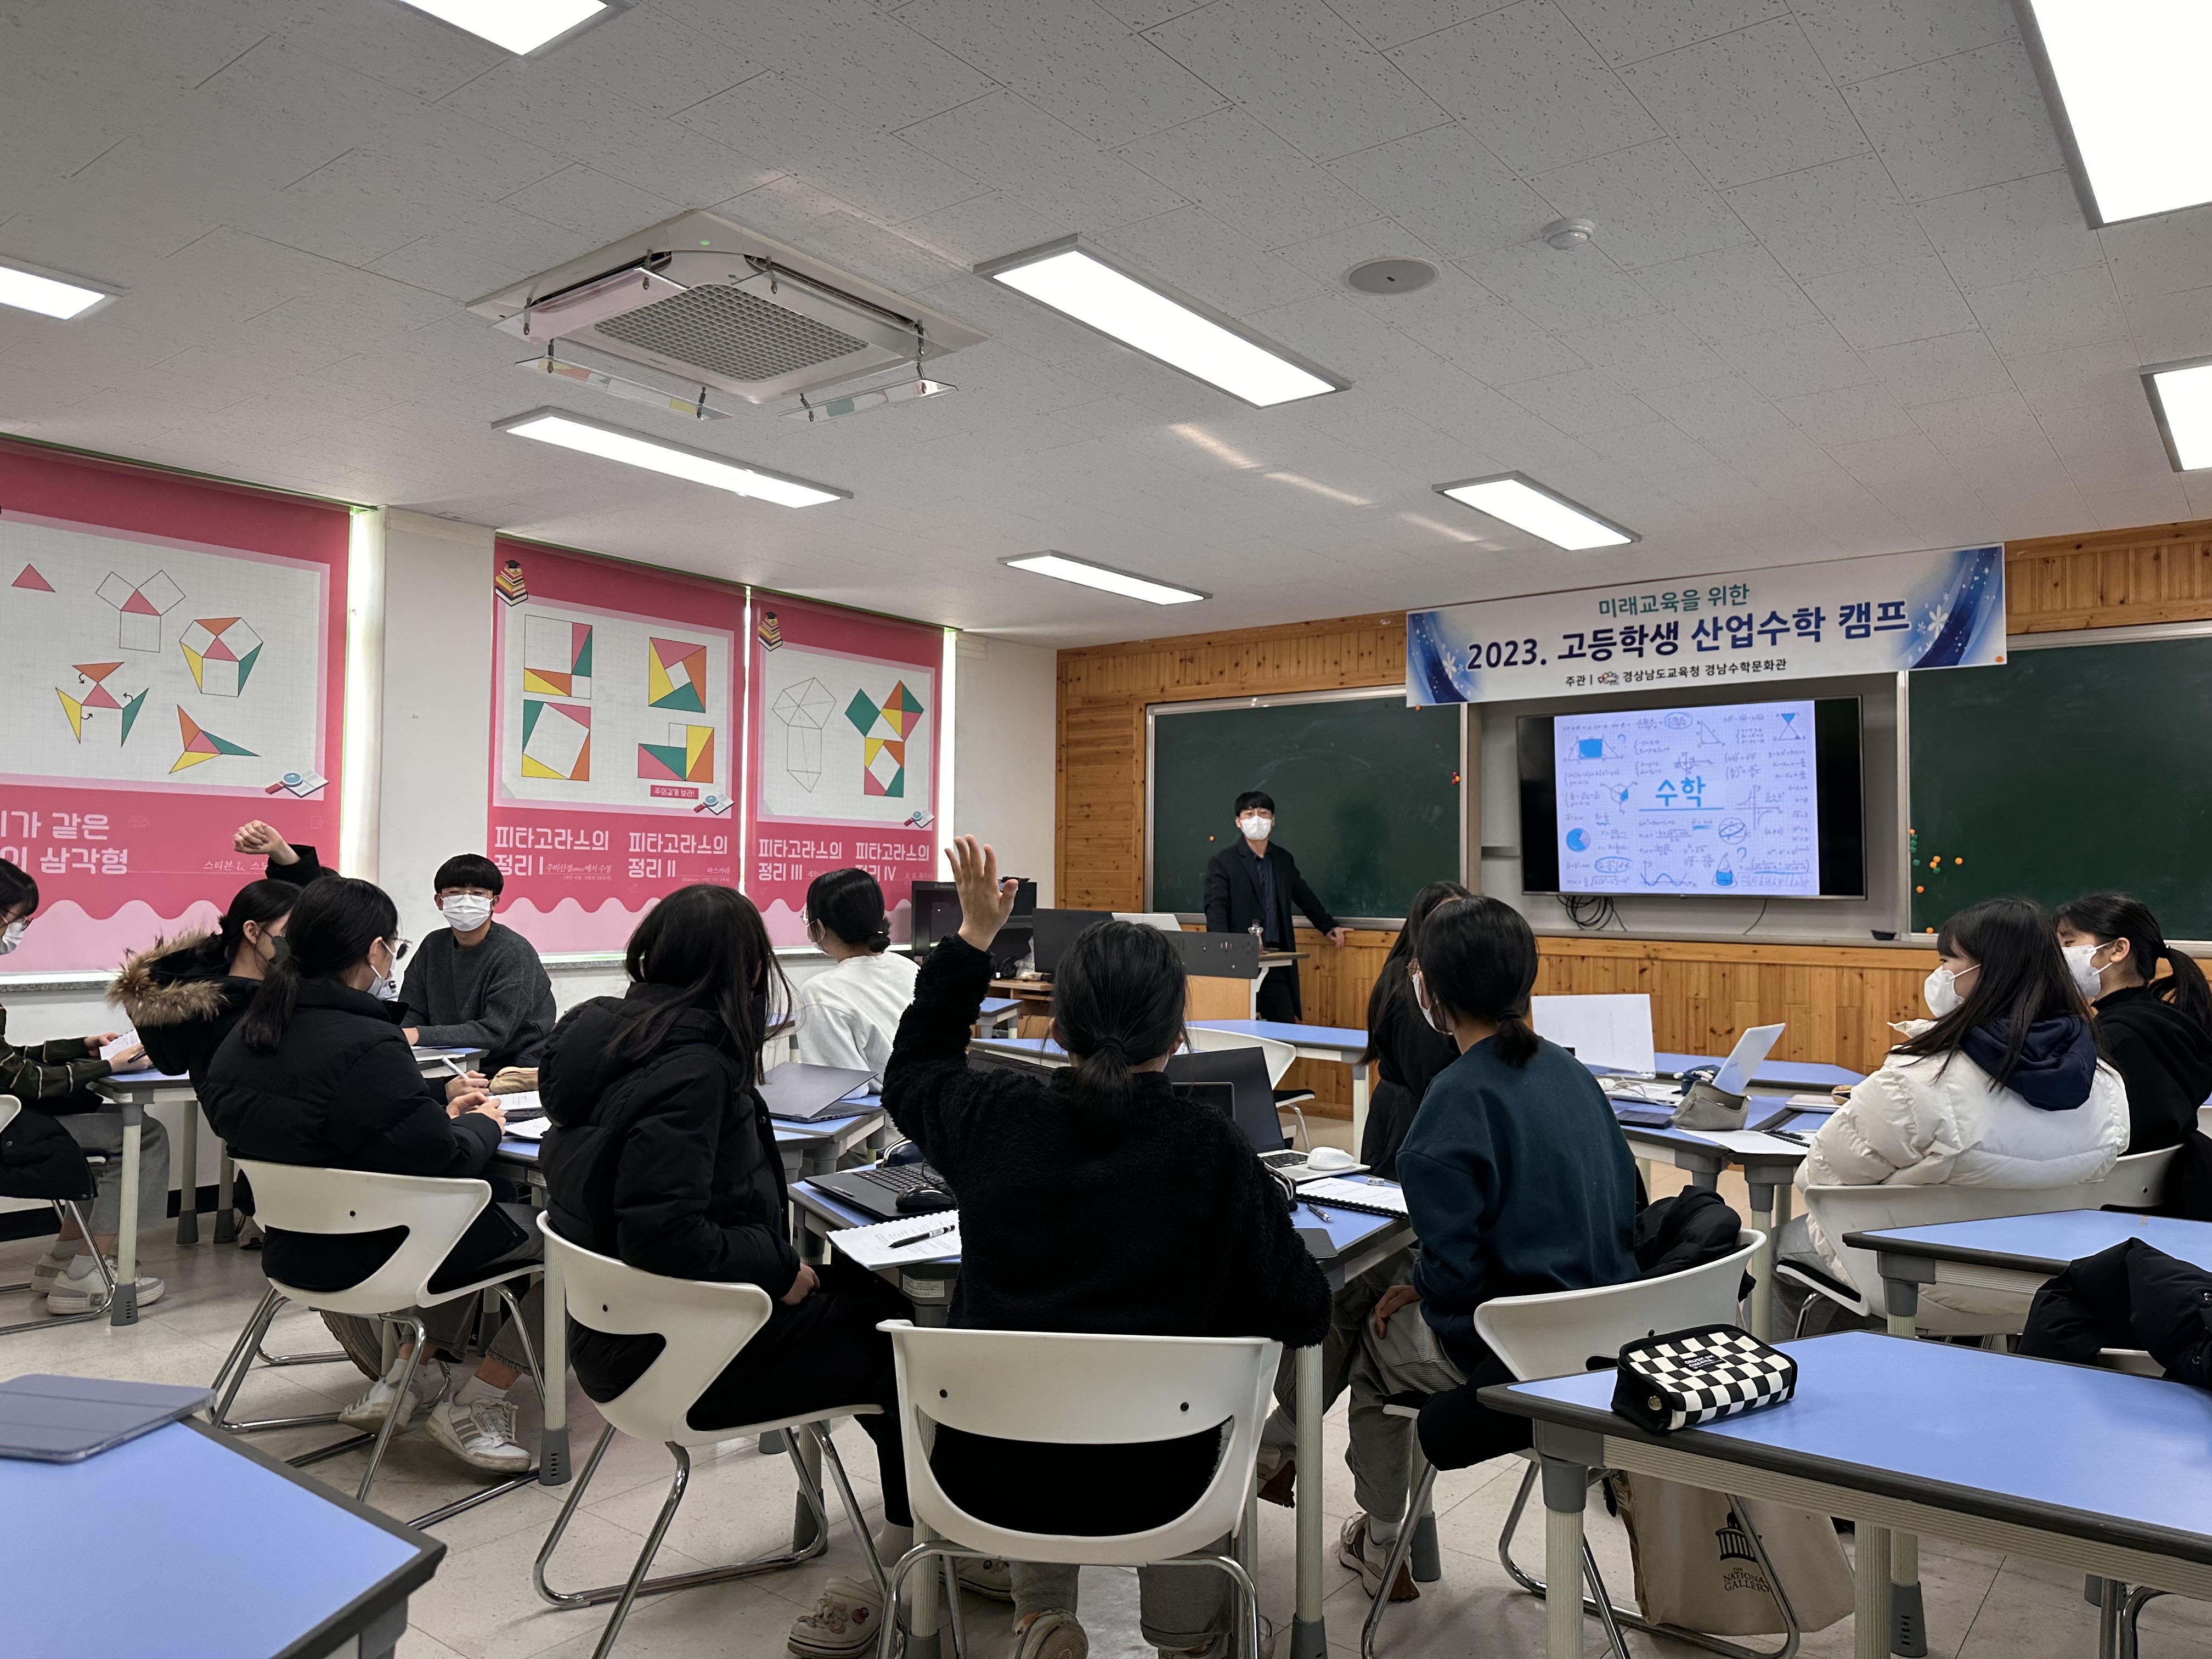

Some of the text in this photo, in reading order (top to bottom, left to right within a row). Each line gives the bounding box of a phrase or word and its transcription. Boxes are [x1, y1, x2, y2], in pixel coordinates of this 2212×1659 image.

[1599, 583, 1750, 618] 미래교육을 위한
[1467, 600, 1910, 670] 2023. 고등학생 산업수학 캠프
[1565, 658, 1787, 687] 주관 경상남도교육청 경남수학문화관
[1655, 776, 1706, 807] 수학
[52, 812, 109, 840] 같은
[495, 826, 608, 850] 피타고라스의
[629, 832, 727, 854] 피타고라스의
[758, 839, 842, 860] 피타고라스의
[855, 842, 929, 861] 피타고라스의
[40, 848, 127, 874] 삼각형
[202, 860, 234, 871] 스티븐
[494, 854, 532, 876] 정리
[629, 858, 662, 878] 정리
[758, 862, 786, 881] 정리
[884, 865, 896, 881] IV
[1723, 1572, 1765, 1583] NATIONA
[1724, 1579, 1770, 1592] GALLERY
